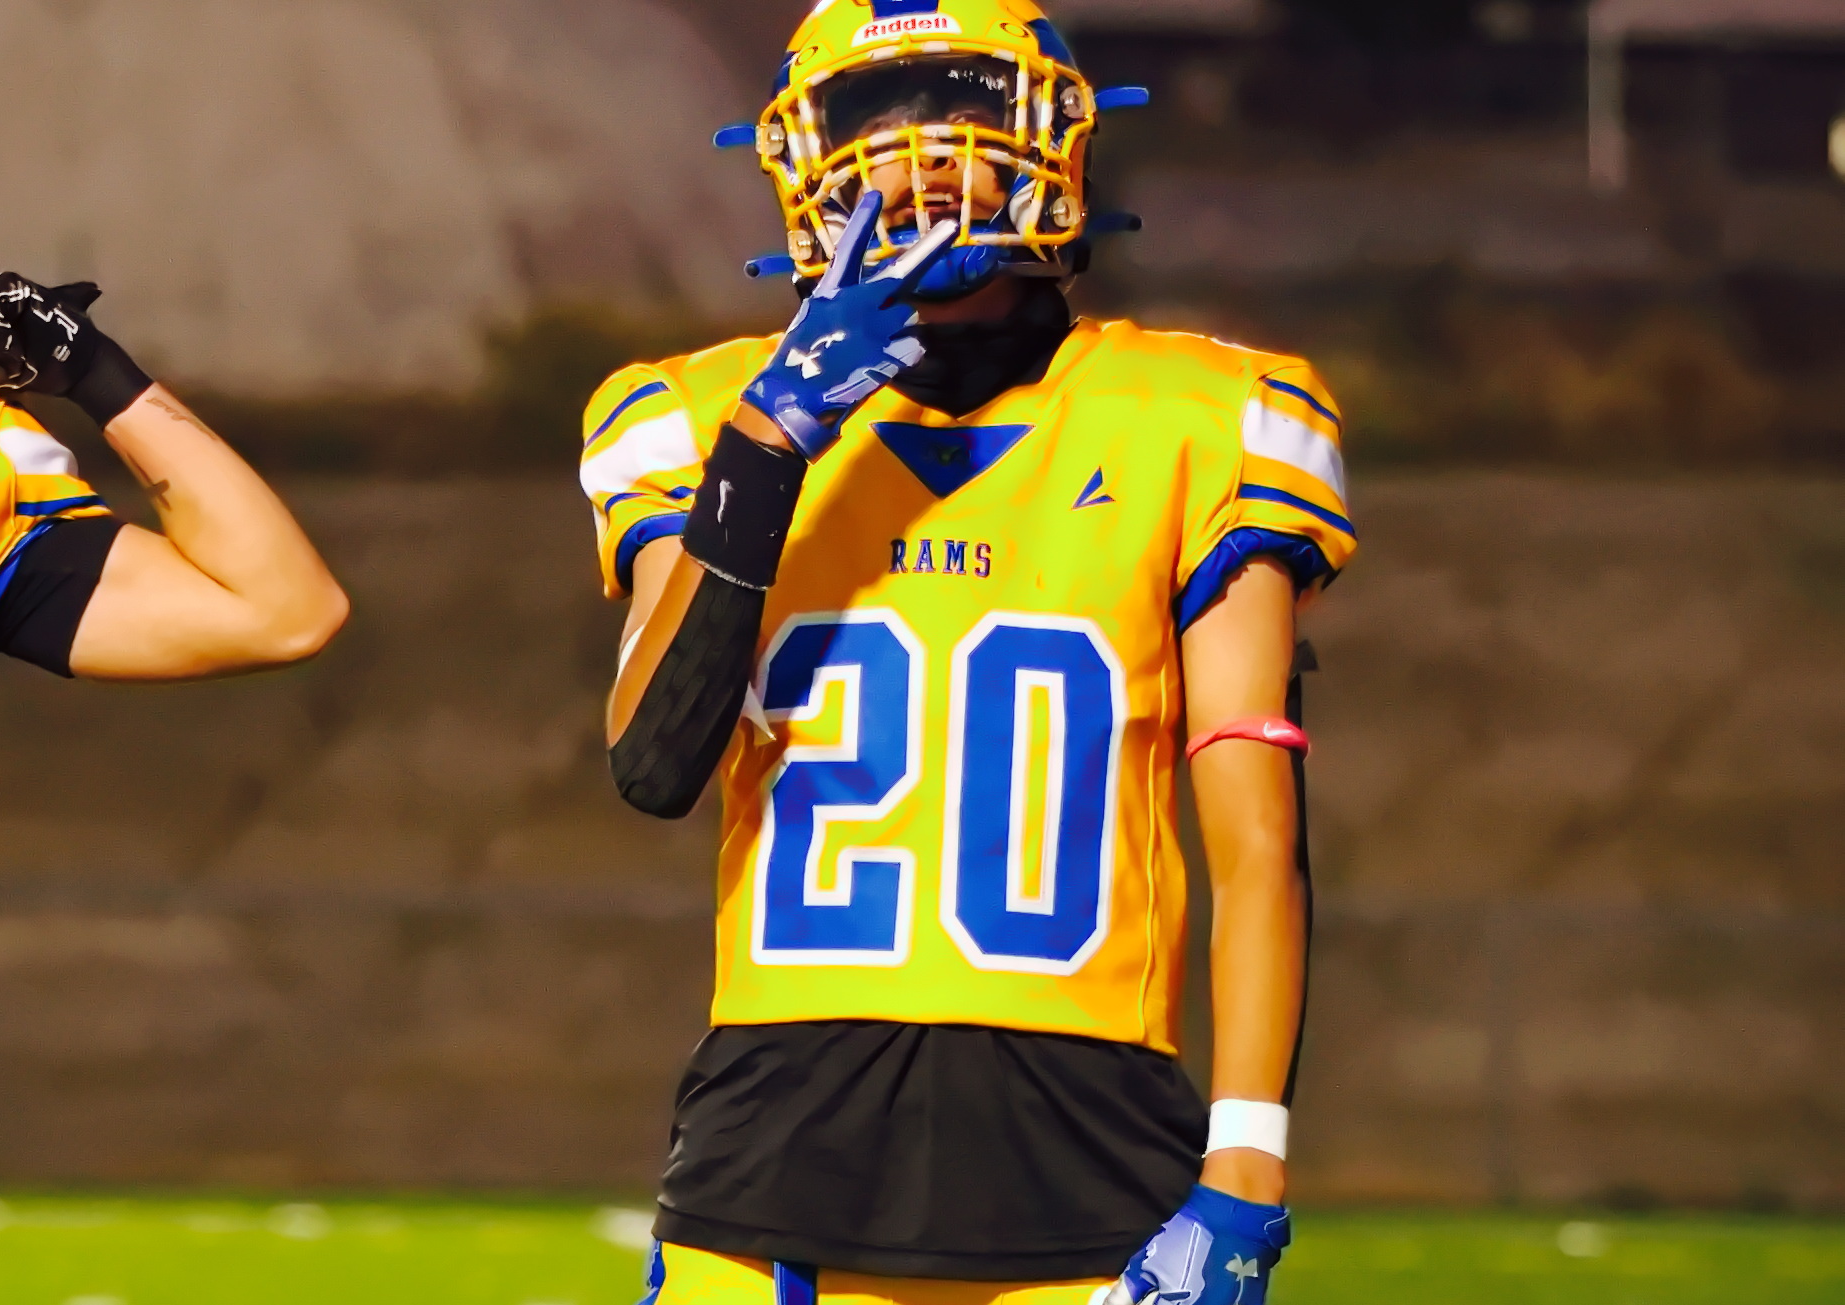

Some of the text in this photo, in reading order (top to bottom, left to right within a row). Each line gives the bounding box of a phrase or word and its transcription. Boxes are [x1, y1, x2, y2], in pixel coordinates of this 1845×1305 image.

[863, 17, 948, 38] Riddell
[888, 538, 991, 579] RAMS
[751, 607, 1125, 976] 20
